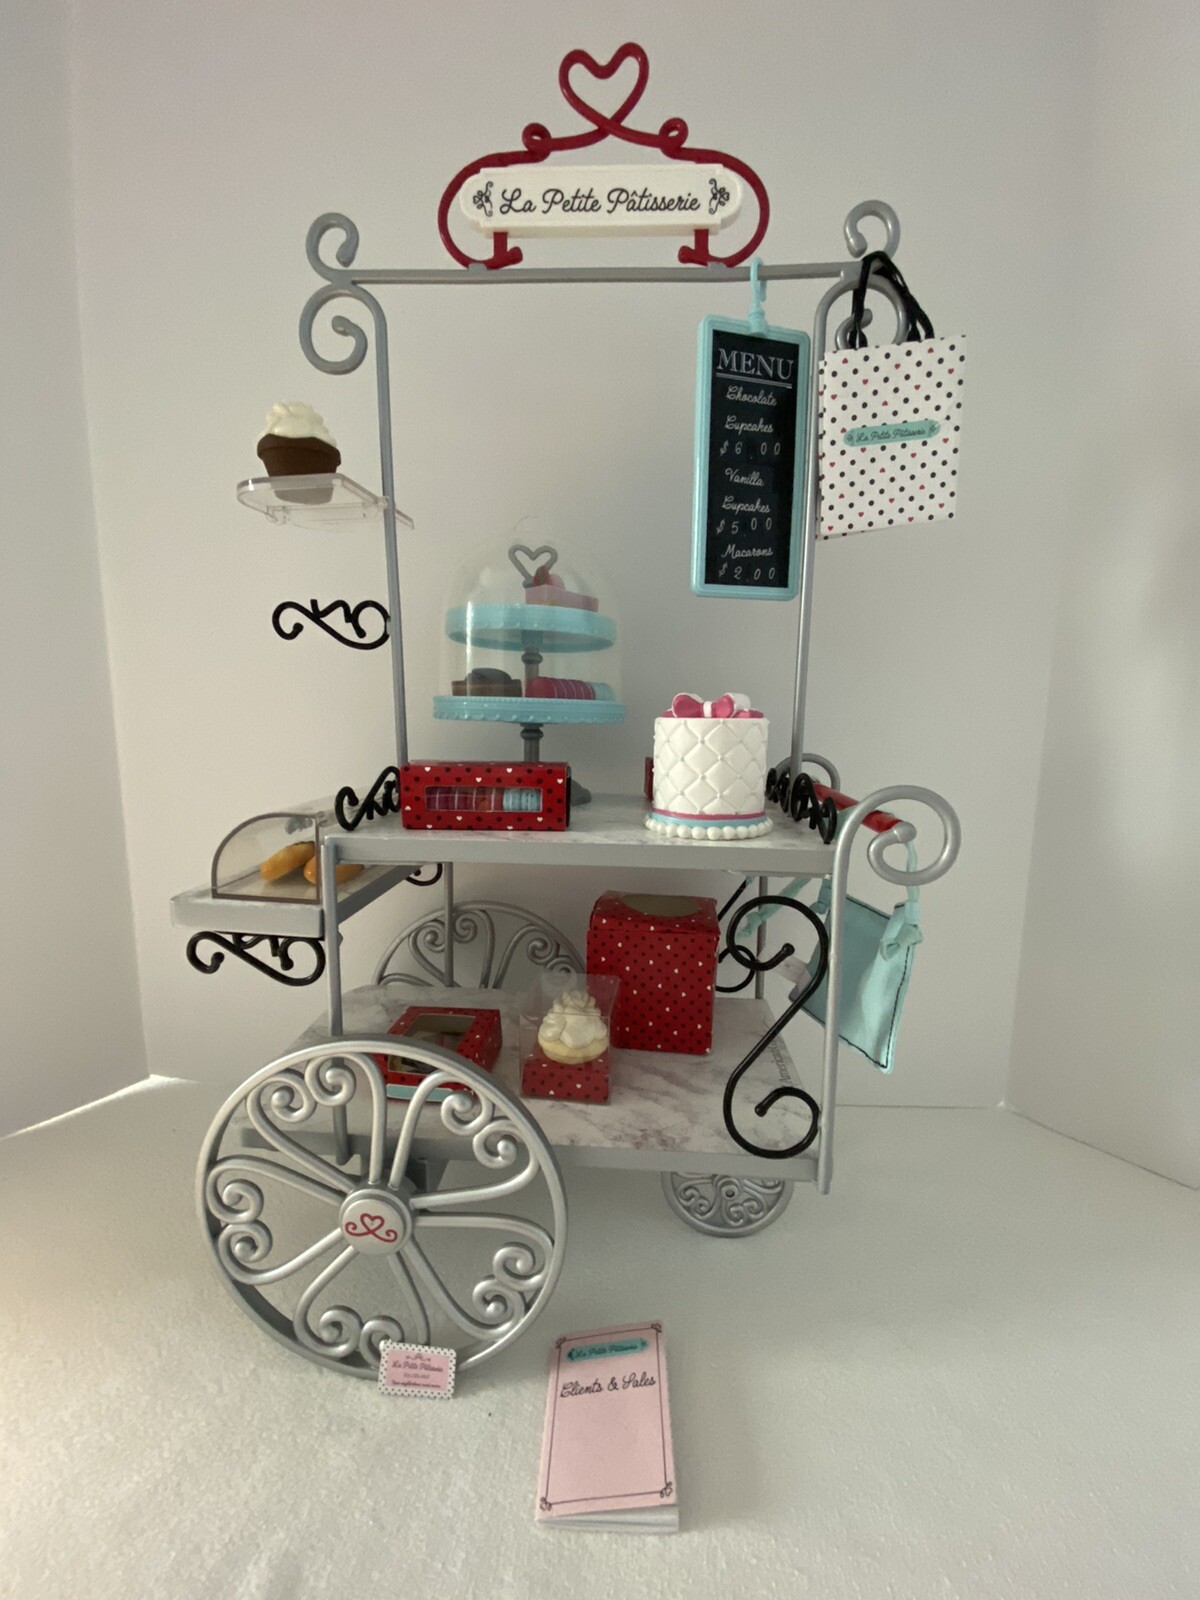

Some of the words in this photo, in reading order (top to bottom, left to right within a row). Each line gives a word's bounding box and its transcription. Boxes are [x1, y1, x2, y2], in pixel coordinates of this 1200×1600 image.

[500, 188, 536, 213] La
[542, 187, 601, 213] Petite
[606, 187, 701, 213] Pâtisserie
[716, 348, 794, 380] MENU
[726, 385, 777, 406] Chocolate
[724, 415, 774, 434] Cupcakes
[725, 468, 765, 487] Vanilla
[721, 495, 771, 514] Cupcakes
[721, 545, 773, 559] Macarons
[560, 1379, 603, 1397] Clients
[607, 1377, 618, 1391] &
[622, 1371, 656, 1389] Sales
